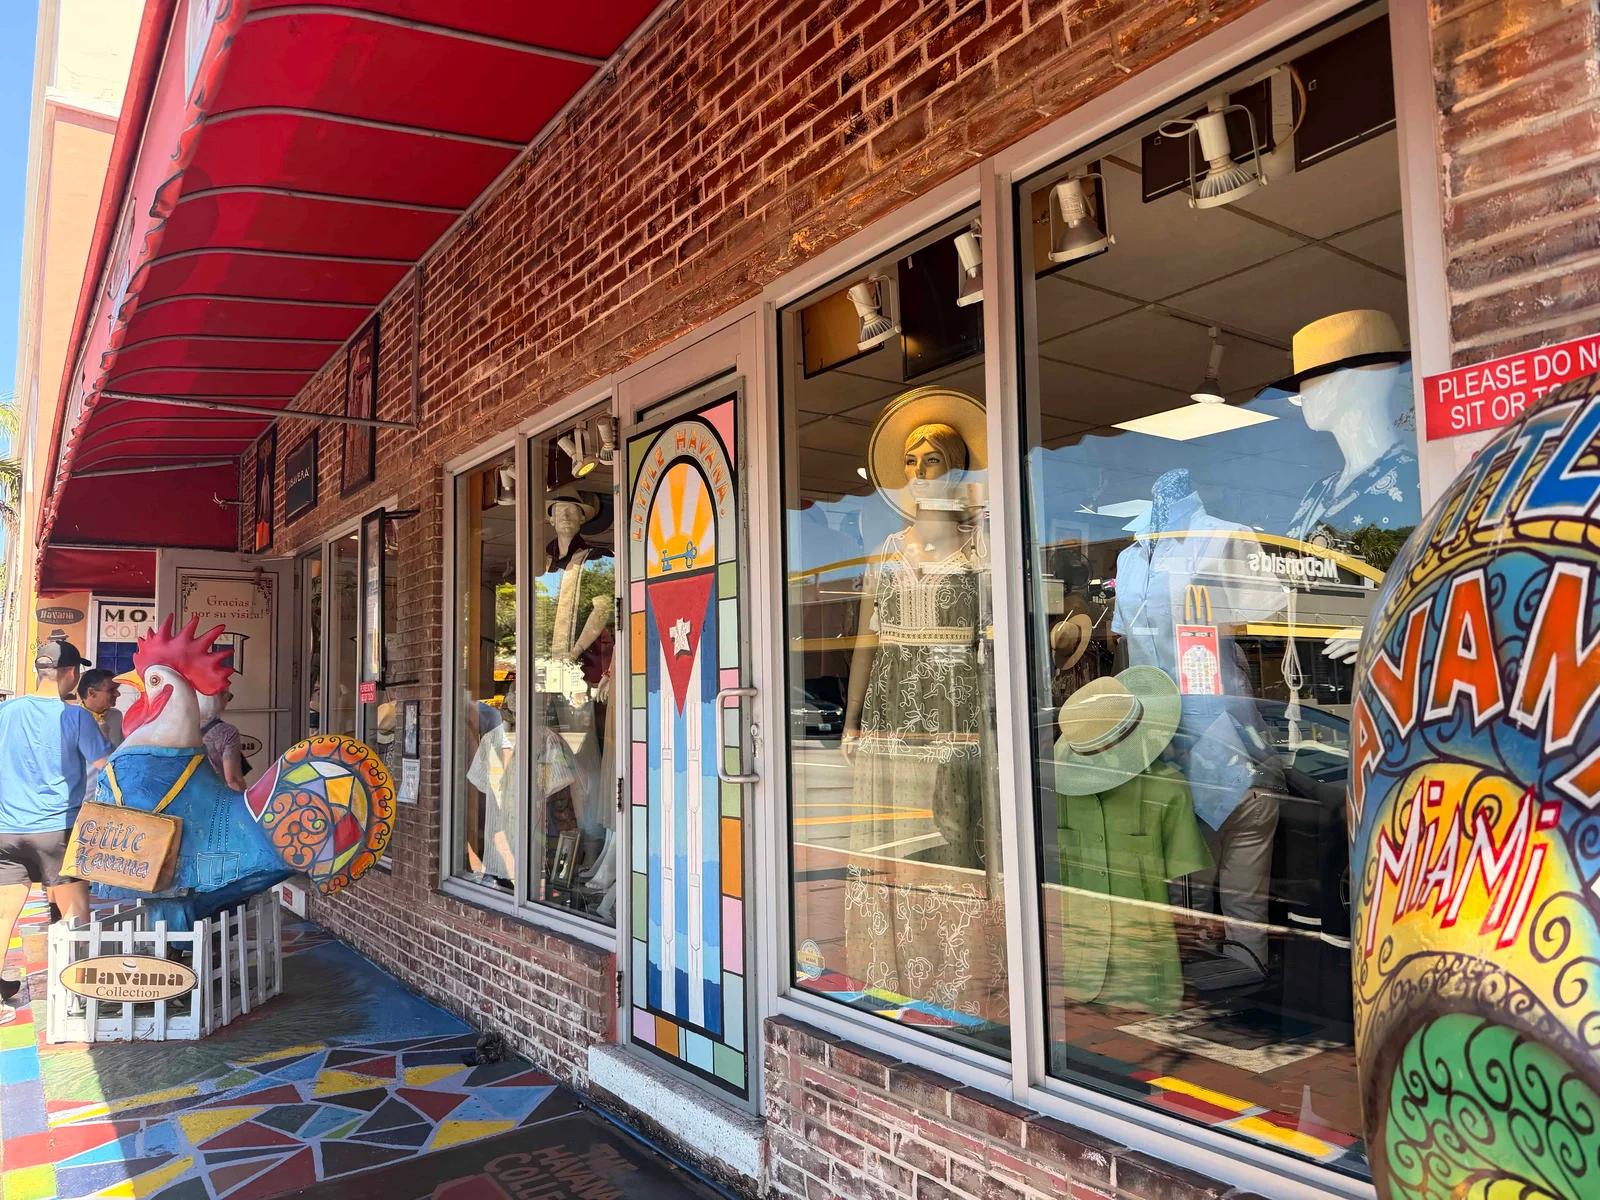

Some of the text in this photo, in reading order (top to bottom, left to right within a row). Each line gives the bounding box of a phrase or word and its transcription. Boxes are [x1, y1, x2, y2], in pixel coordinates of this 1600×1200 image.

[1438, 360, 1528, 403] PLEASE
[1533, 349, 1572, 380] DO
[1450, 399, 1486, 431] SIT
[1491, 393, 1526, 420] OR
[631, 446, 665, 543] LITTLE
[206, 594, 250, 608] Gracias
[105, 609, 156, 622] MO
[191, 610, 211, 620] por
[214, 611, 227, 619] su
[74, 819, 146, 853] Little
[74, 967, 183, 987] Havana
[95, 985, 160, 999] Collection
